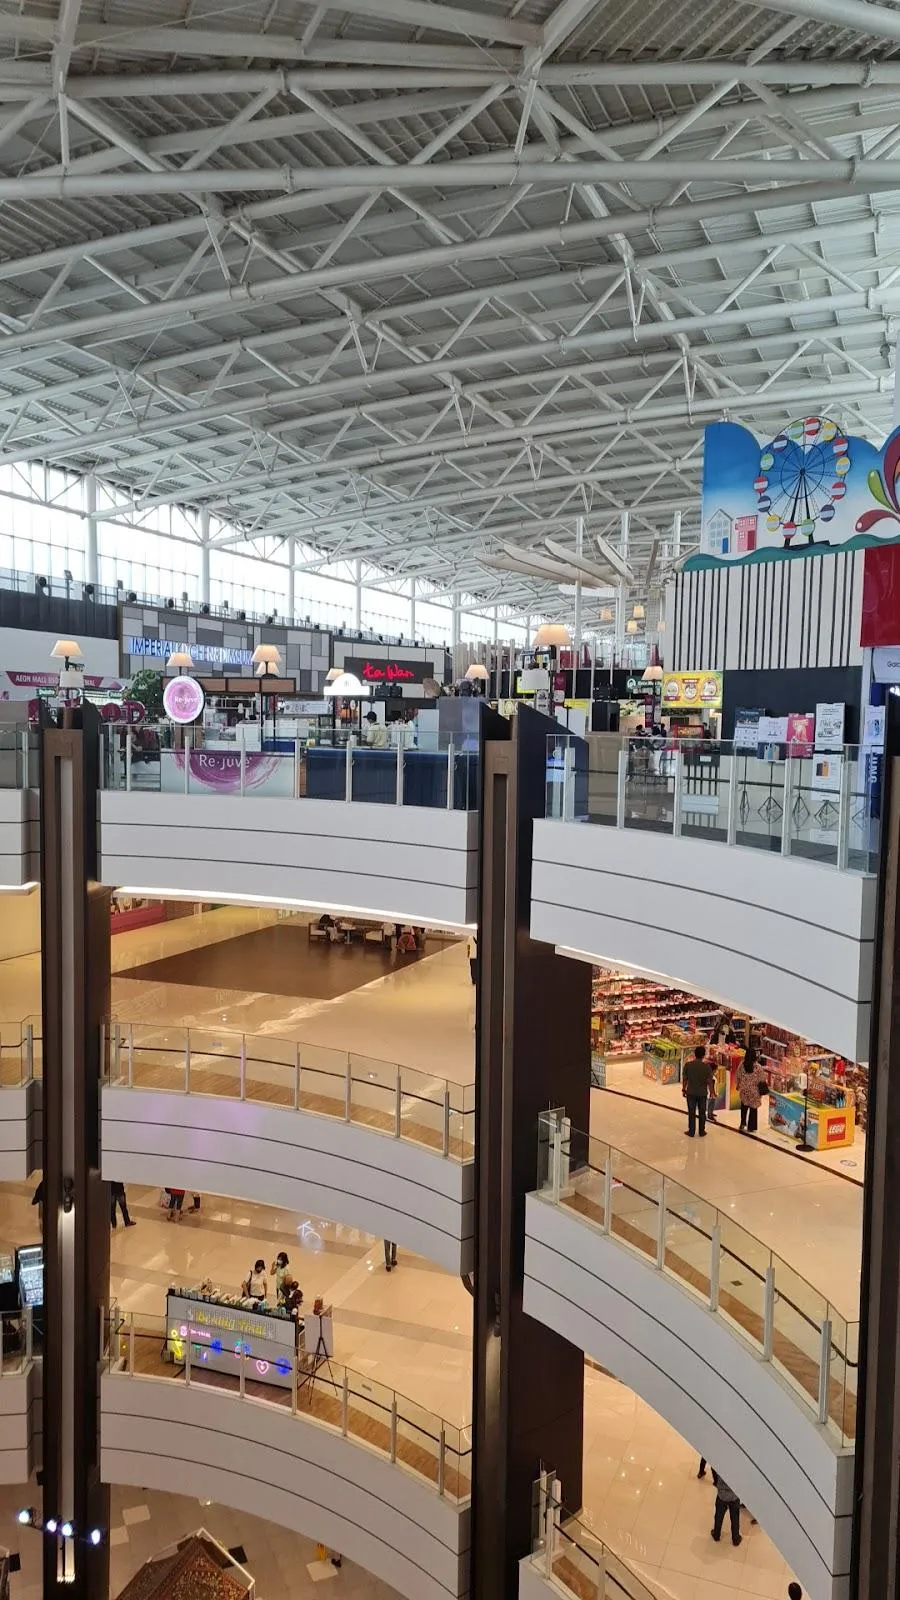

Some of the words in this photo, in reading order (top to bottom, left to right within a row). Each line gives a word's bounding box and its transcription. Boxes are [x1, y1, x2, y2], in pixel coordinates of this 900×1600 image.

[132, 637, 175, 657] IMPERIAL
[32, 676, 47, 684] MALL
[828, 1123, 845, 1134] LEGO
